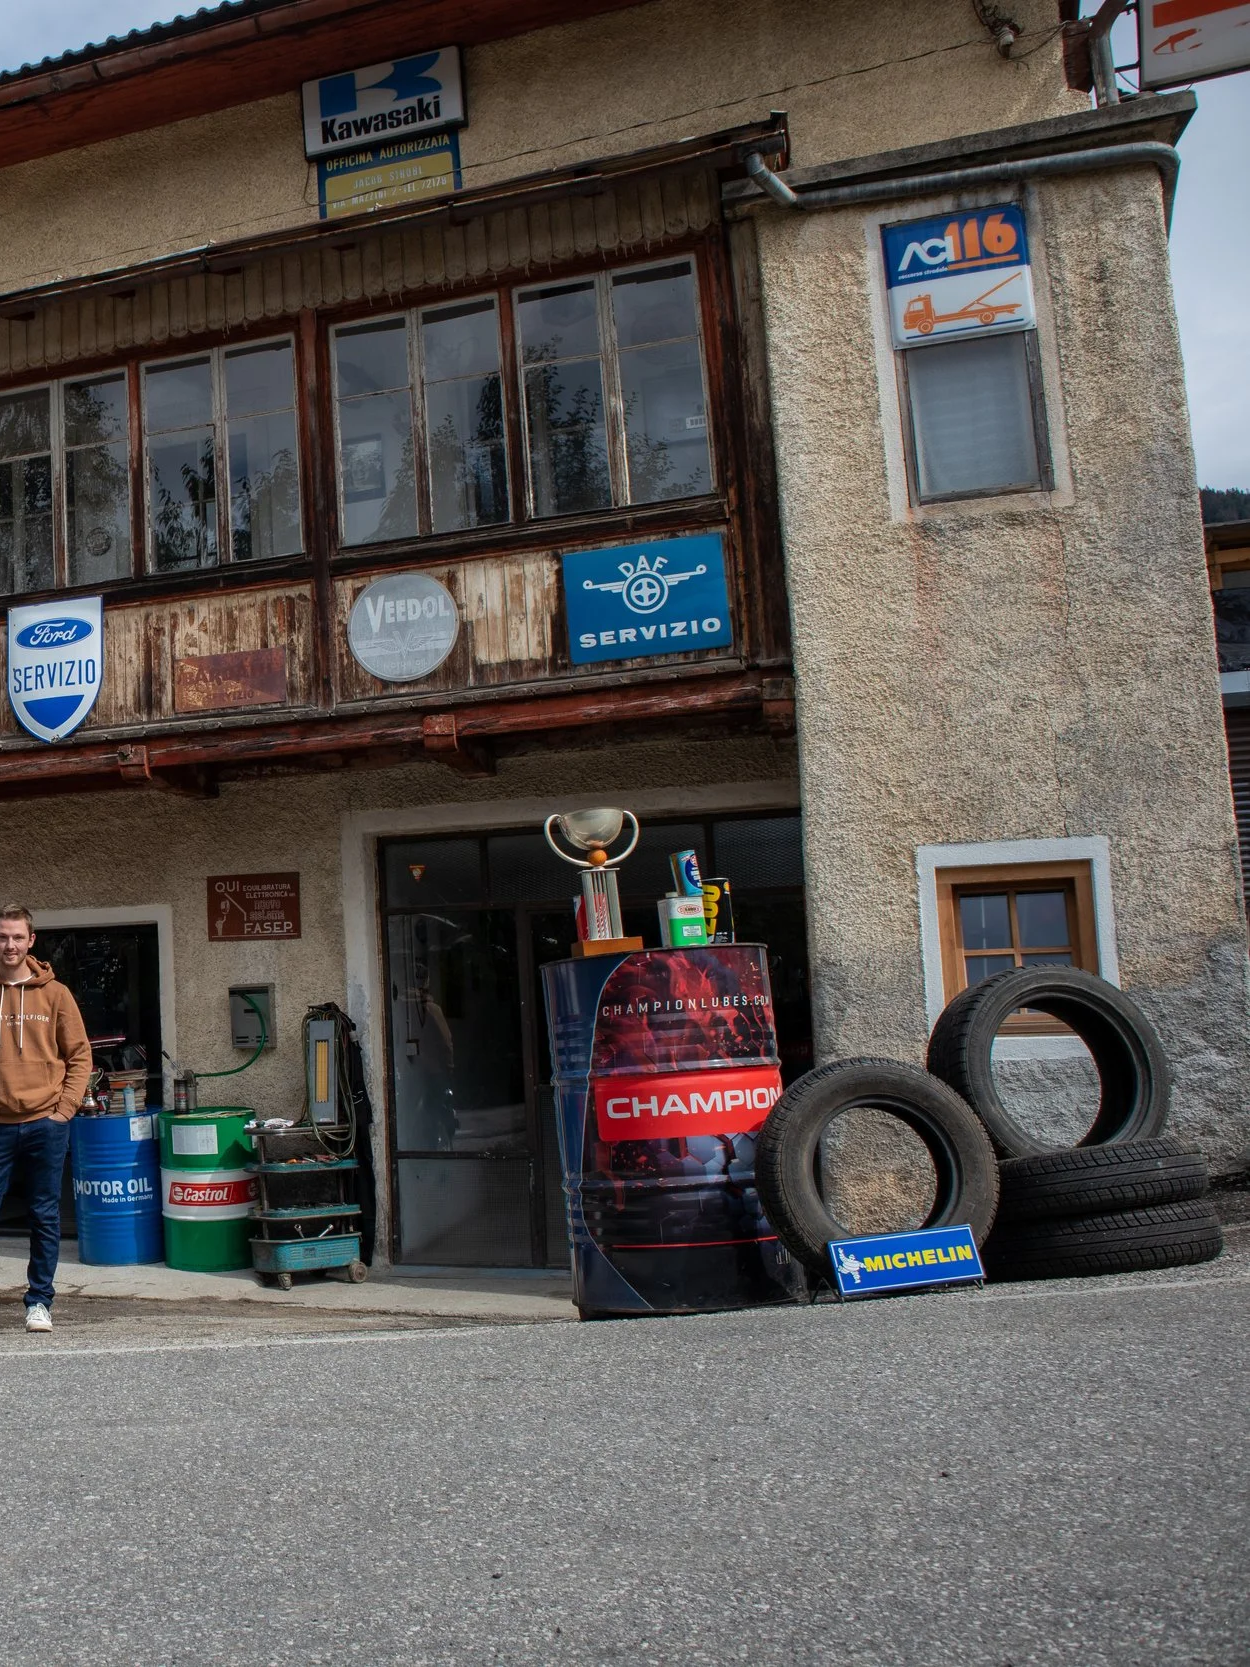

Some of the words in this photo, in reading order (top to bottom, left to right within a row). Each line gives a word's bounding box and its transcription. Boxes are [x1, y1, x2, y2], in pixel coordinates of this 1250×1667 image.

[321, 96, 441, 144] Kawasaki
[326, 151, 373, 172] OFFICINA
[379, 134, 450, 161] AUTORIZZATA
[898, 235, 955, 271] ACI
[944, 213, 1017, 261] 116
[617, 555, 668, 578] DAF
[365, 594, 450, 633] VEEDOL
[29, 622, 77, 646] Ford
[579, 617, 721, 648] SERVIZIO
[13, 658, 96, 694] SERVIZIO
[215, 881, 240, 893] QUI
[242, 883, 291, 892] EQUILIBRATURA
[245, 891, 288, 899] ELETTRONICA
[17, 1014, 49, 1022] HILFIGER
[606, 1083, 782, 1119] CHAMPION
[76, 1180, 124, 1196] MOTOR
[126, 1177, 152, 1194] OIL
[127, 1194, 153, 1202] Germany
[183, 1187, 228, 1202] Castrol
[864, 1244, 974, 1273] MICHELIN
